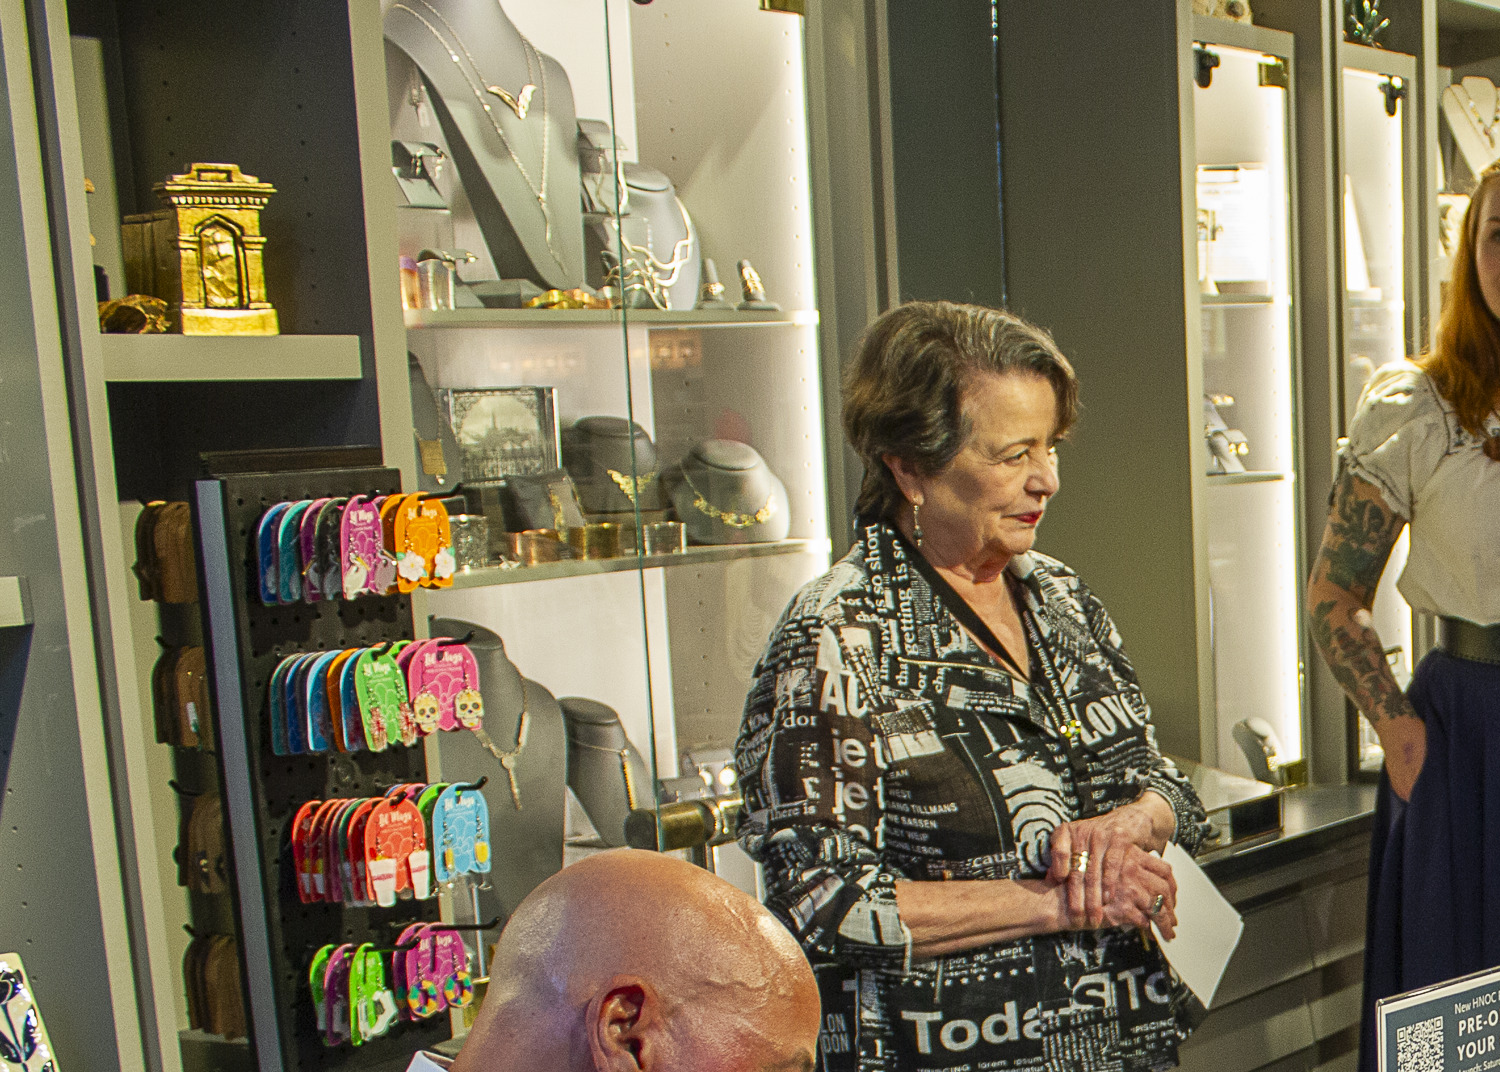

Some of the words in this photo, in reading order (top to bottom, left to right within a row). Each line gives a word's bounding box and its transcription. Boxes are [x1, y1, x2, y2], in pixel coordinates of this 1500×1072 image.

[865, 523, 882, 571] short
[871, 574, 885, 596] so
[892, 565, 909, 582] is
[897, 587, 919, 655] getting
[1038, 648, 1053, 679] Orleans
[910, 802, 958, 815] TILLMANS
[1454, 1002, 1471, 1014] New
[1472, 992, 1497, 1008] HNOC
[1456, 1035, 1496, 1061] YOUR
